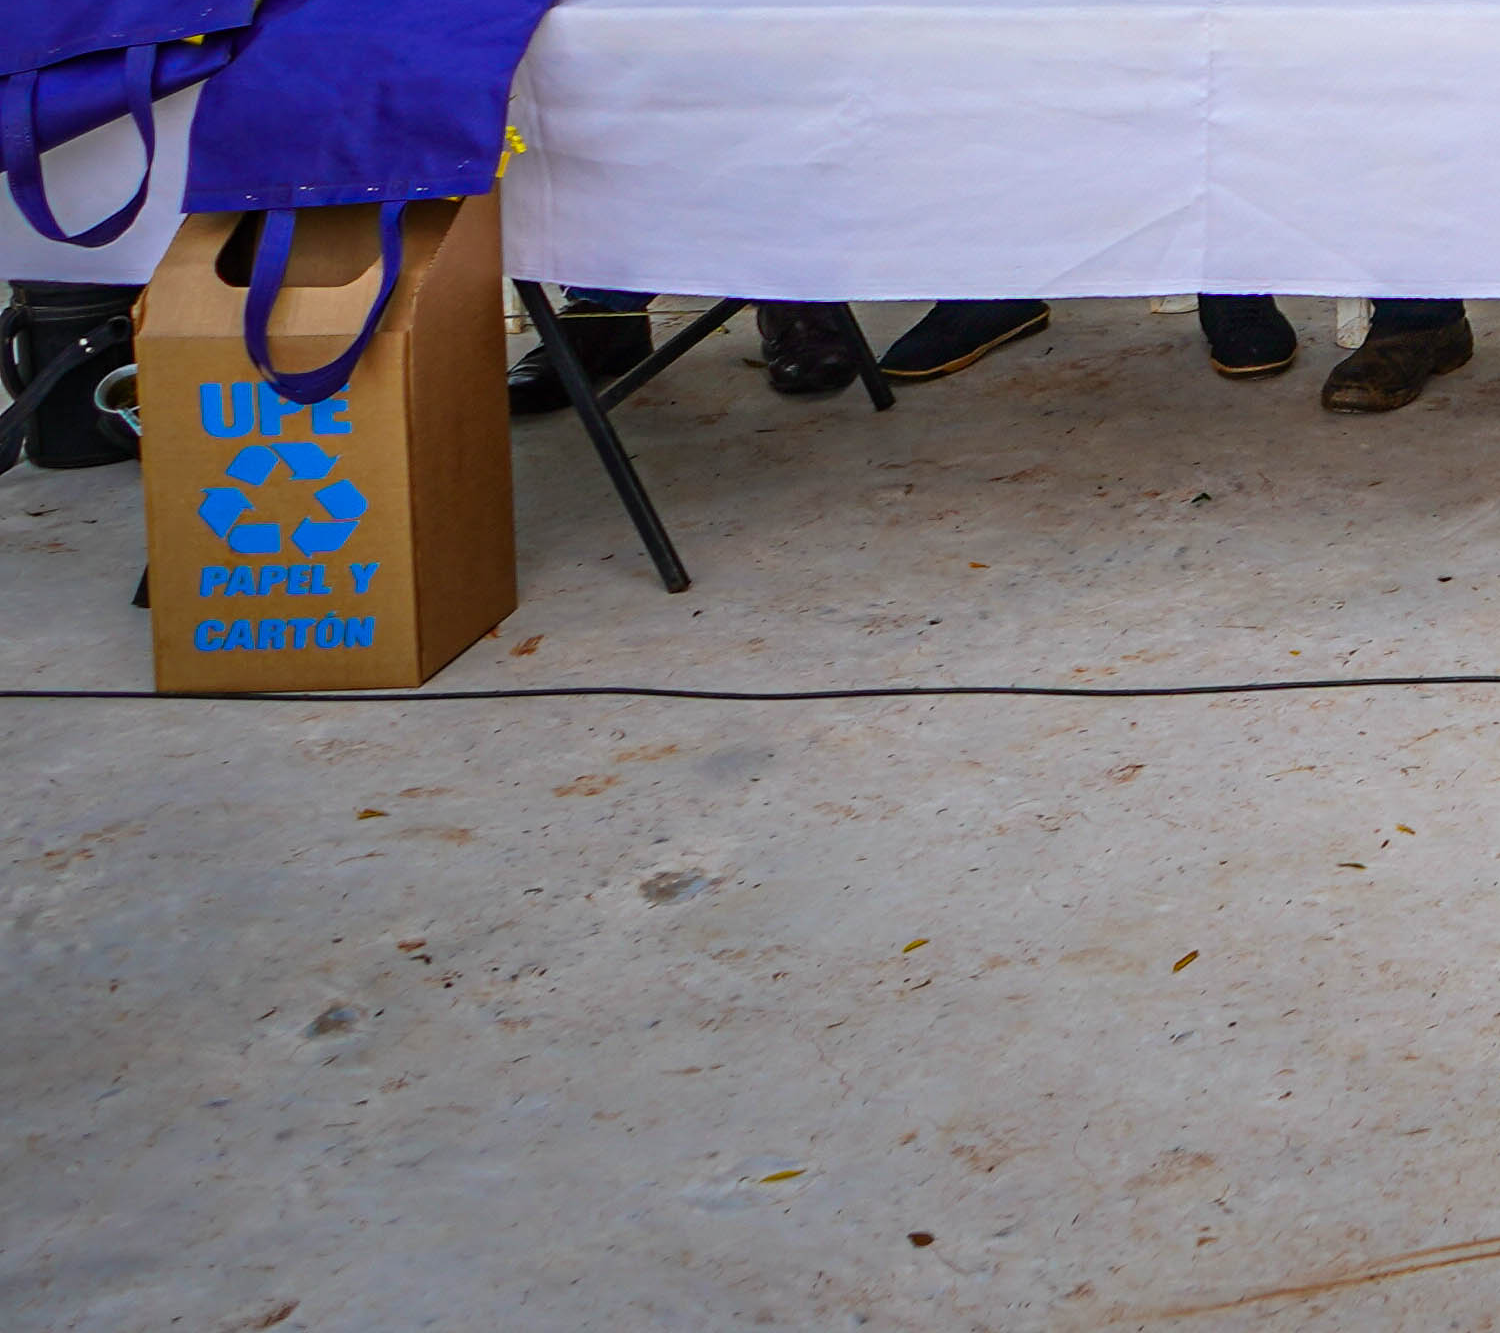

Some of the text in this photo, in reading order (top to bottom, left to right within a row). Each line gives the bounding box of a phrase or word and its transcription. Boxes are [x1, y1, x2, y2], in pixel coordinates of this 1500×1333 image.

[199, 561, 381, 597] PAPEL Y
[194, 609, 376, 652] CARTÓN
